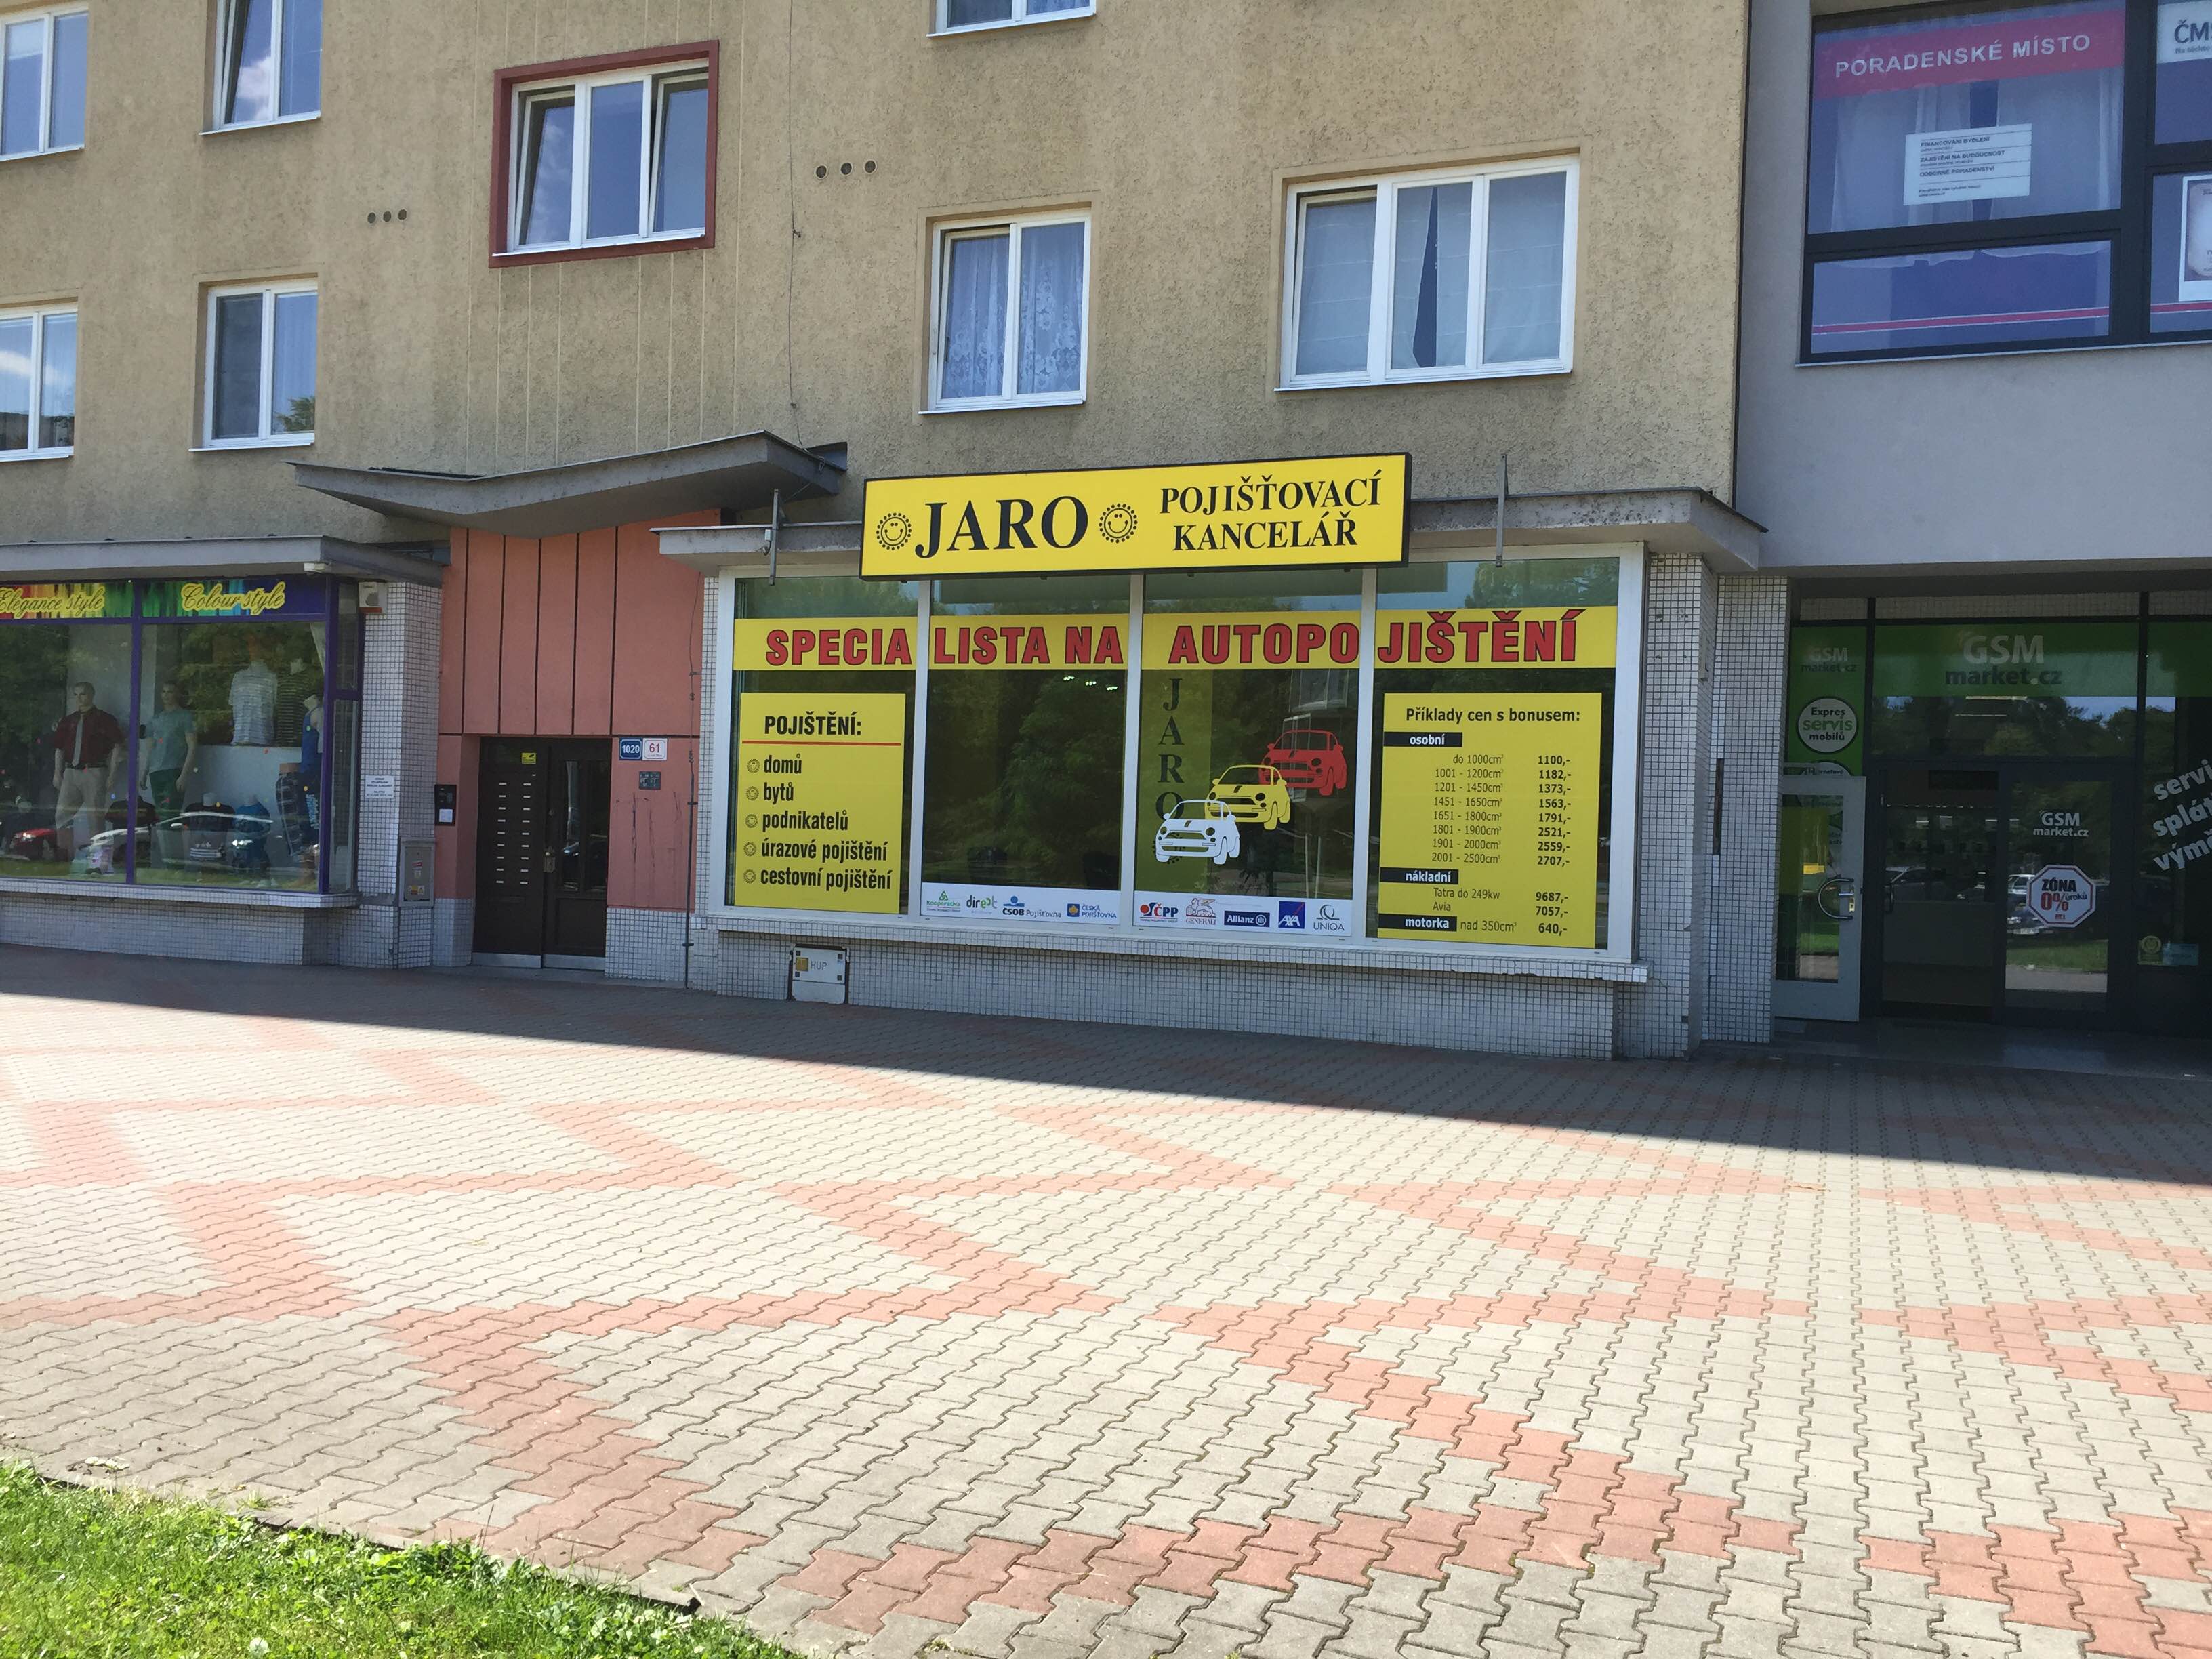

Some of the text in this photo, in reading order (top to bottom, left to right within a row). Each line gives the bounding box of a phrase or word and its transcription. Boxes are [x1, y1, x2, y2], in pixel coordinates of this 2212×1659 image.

[2174, 19, 2212, 44] ČM
[1835, 34, 2091, 78] PORADENSKÉ MÍSTO
[914, 469, 1382, 560] JARO POJIŠŤOVACÍ
[1172, 511, 1359, 552] KANCELÁŘ
[183, 582, 285, 615] Colour style
[1064, 626, 1124, 665] NA
[1965, 634, 2045, 665] GSM
[1809, 646, 1849, 662] GSM
[1945, 668, 2062, 686] market.cz
[1406, 706, 1580, 725] Příklady cen s bonusem:
[1811, 707, 1846, 717] Expres
[764, 710, 863, 736] POJIŠTĚNÍ:
[1802, 716, 1853, 731] servis
[1409, 733, 1446, 746] osobní
[1809, 731, 1845, 741] mobilů
[621, 743, 660, 754] 1020 61
[763, 753, 802, 774] domů
[1452, 754, 1464, 764] do
[1435, 769, 1456, 778] 1001
[763, 781, 794, 805] bytů
[1435, 782, 1456, 792] 1201
[1433, 796, 1455, 806] 1451
[762, 809, 849, 832] podnikatelů
[1433, 811, 1455, 821] 1651
[2041, 812, 2081, 827] GSM
[1433, 825, 1454, 834] 1801
[2033, 826, 2089, 837] market.cz
[761, 837, 889, 863] úrazové pojištění
[1432, 838, 1454, 848] 1901
[1431, 853, 1453, 863] 2001
[760, 867, 893, 892] cestovní pojištění
[1405, 869, 1452, 883] nákladní
[2041, 877, 2077, 893] ZÓNA
[1433, 887, 1455, 898] Tatra
[1457, 888, 1469, 899] do
[1471, 889, 1500, 899] 249kw
[1002, 907, 1025, 916] ČSOB
[1153, 902, 1179, 918] ČPP
[1433, 901, 1451, 912] Avia
[1185, 918, 1217, 926] GENERALI
[1227, 914, 1254, 924] Allianz
[1278, 914, 1300, 927] AXA
[1404, 917, 1449, 929] motorka
[1460, 920, 1478, 931] nad
[1313, 922, 1345, 932] UNIQA
[811, 960, 827, 970] HUP
